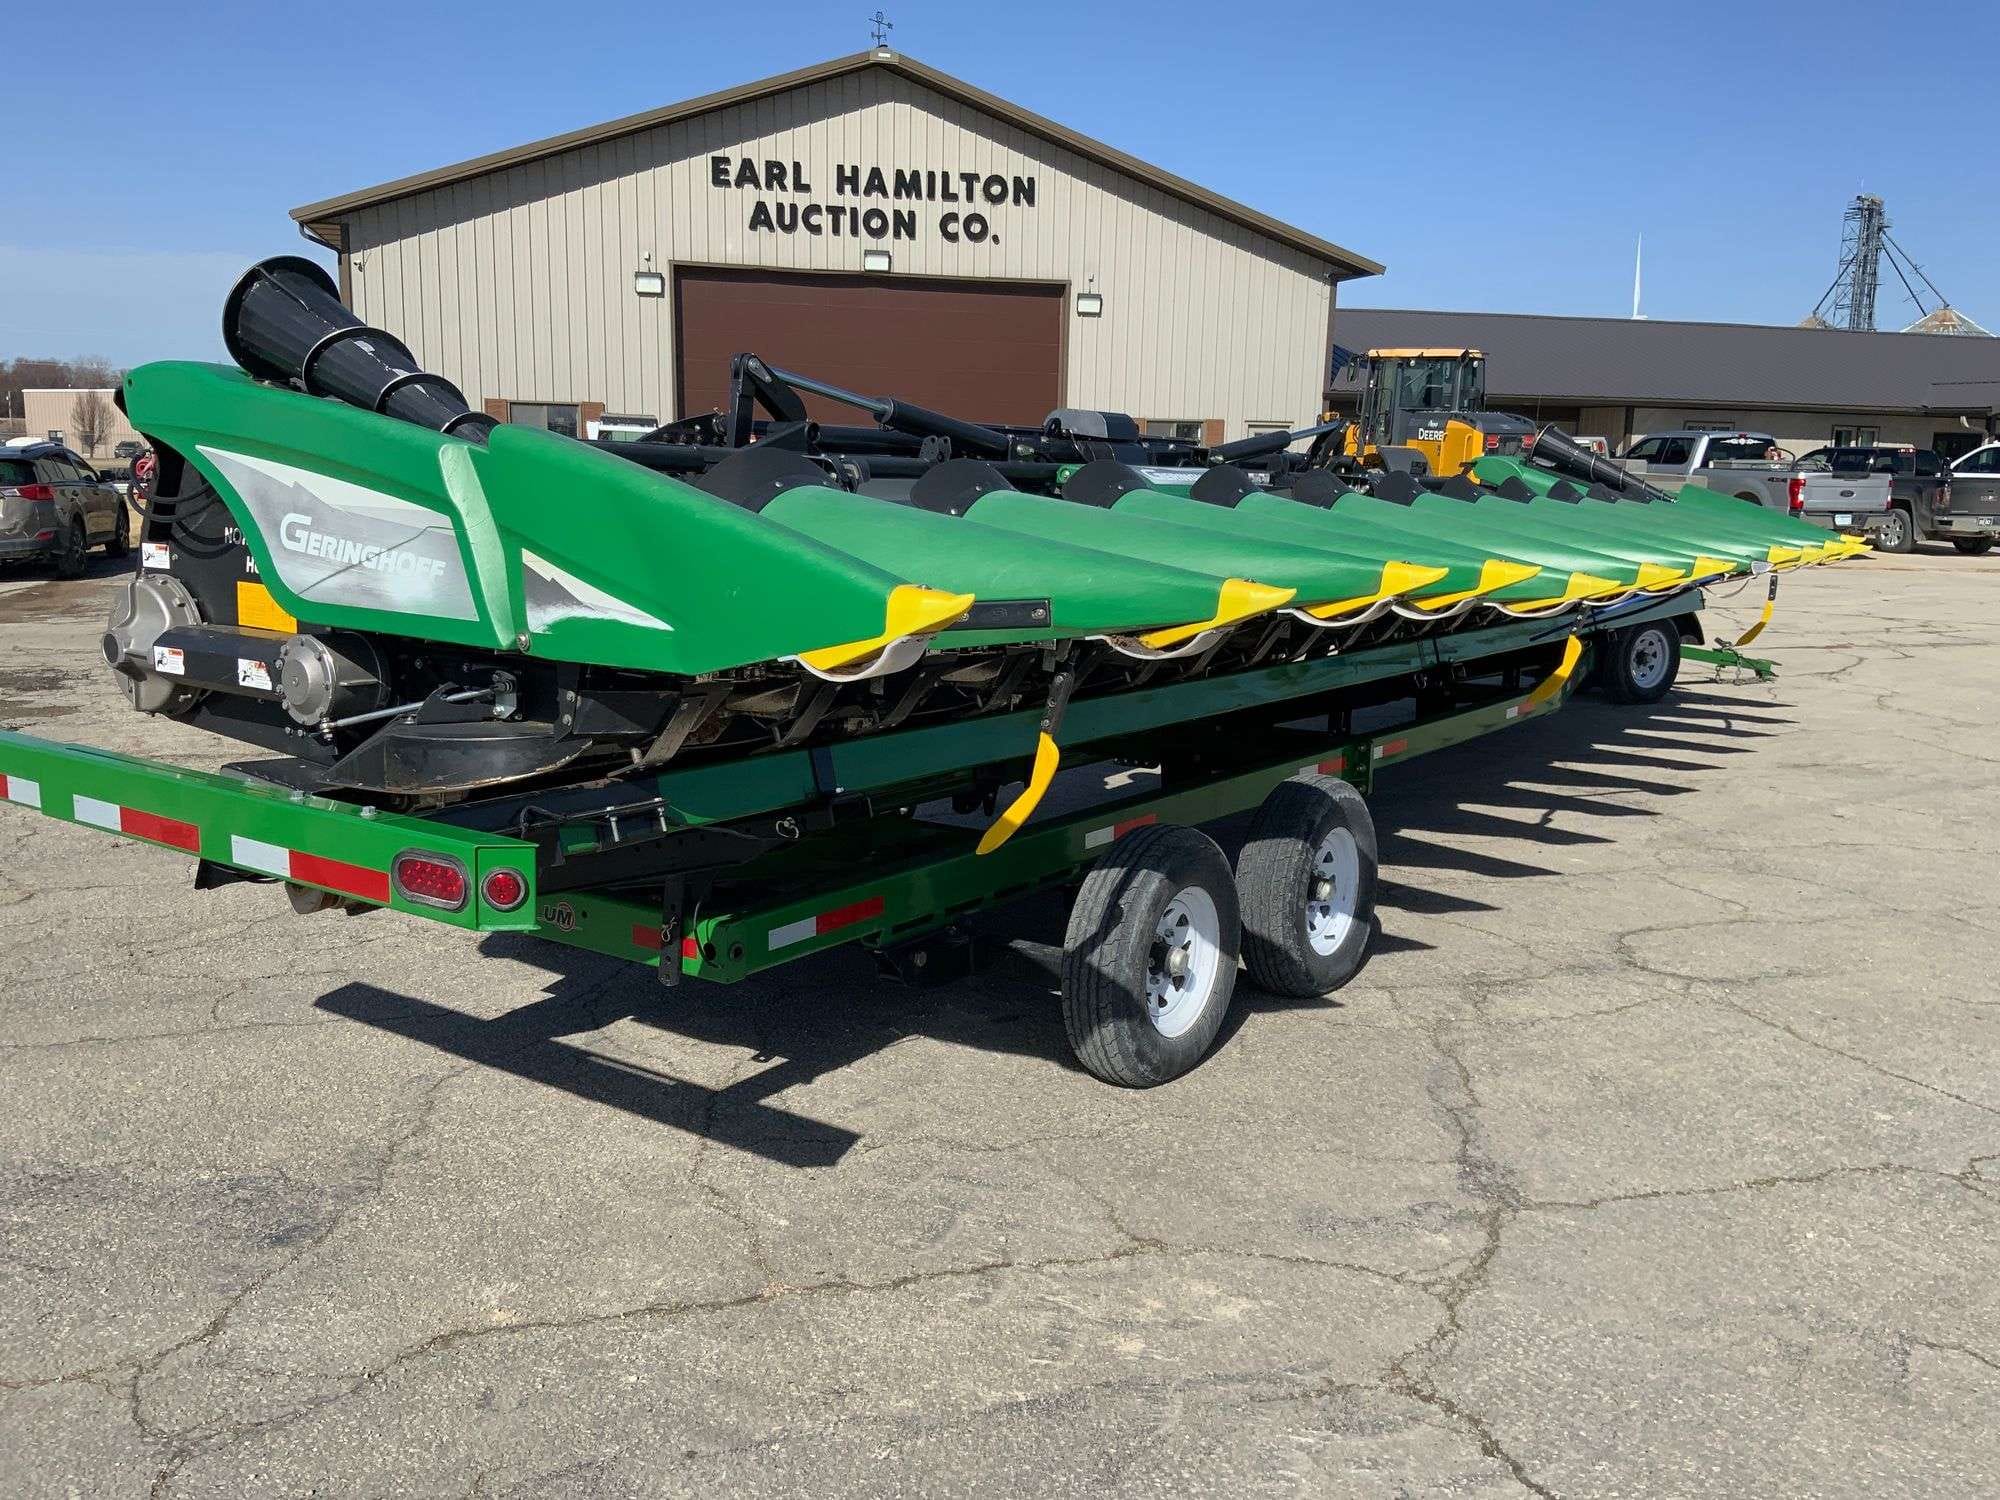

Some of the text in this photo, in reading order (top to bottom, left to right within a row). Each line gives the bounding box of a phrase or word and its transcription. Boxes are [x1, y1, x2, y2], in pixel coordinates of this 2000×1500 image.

[711, 156, 1036, 207] EARL HAMILTON
[749, 201, 1000, 245] AUCTION CO.
[1418, 427, 1444, 440] DEERE
[280, 512, 447, 577] GERINGHOFF
